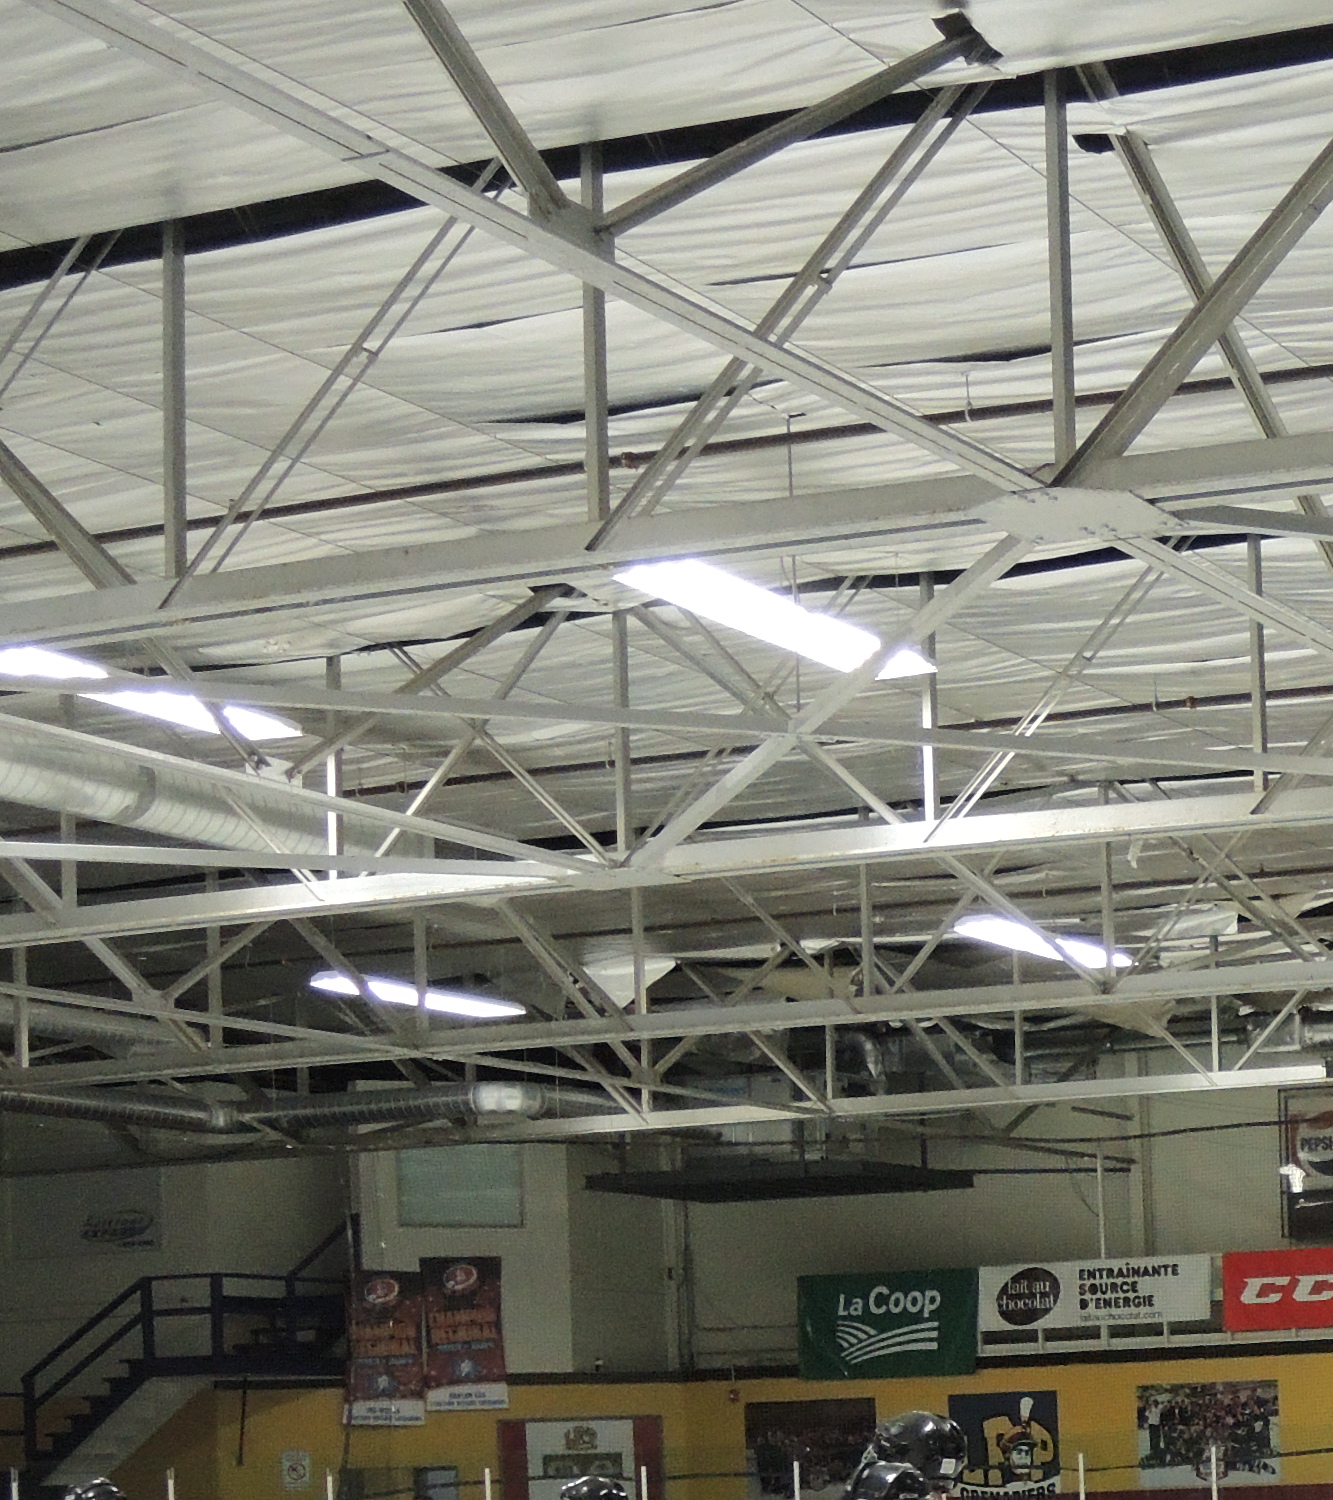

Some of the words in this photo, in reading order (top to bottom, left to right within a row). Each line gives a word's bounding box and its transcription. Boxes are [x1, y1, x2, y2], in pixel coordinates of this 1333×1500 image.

[1008, 1280, 1028, 1294] lait
[1032, 1281, 1050, 1293] au
[1078, 1281, 1138, 1296] SOURCE
[838, 1294, 863, 1316] La
[868, 1286, 941, 1317] Coop
